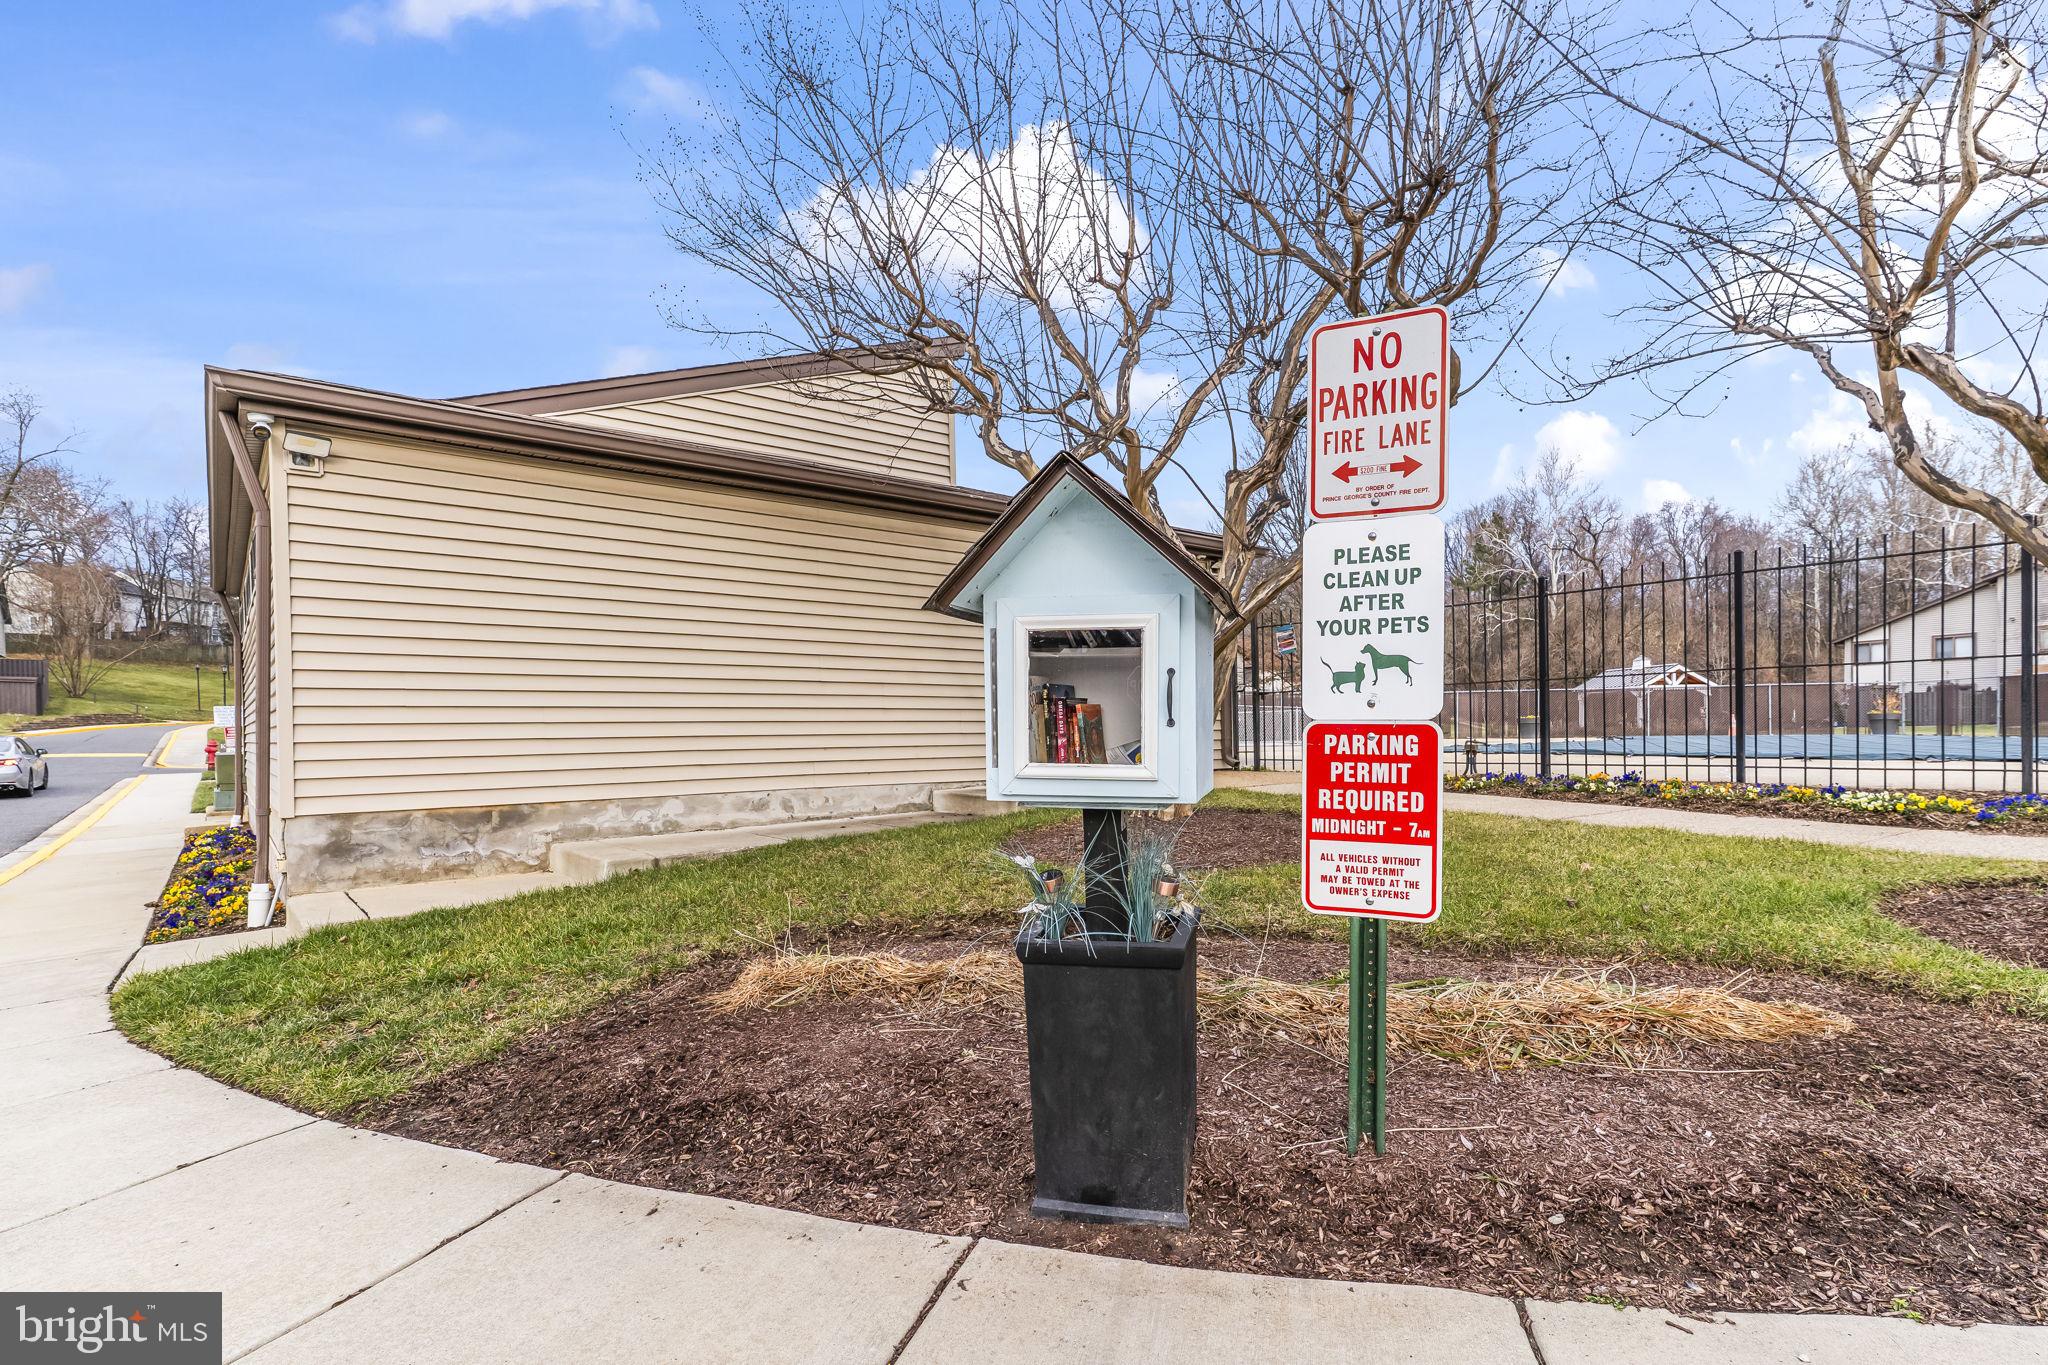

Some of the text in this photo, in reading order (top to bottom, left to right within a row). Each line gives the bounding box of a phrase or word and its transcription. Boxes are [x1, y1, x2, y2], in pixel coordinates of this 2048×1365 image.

[1353, 331, 1402, 373] NO
[1319, 372, 1438, 423] PARKING
[1323, 420, 1431, 455] FIRE LANE
[1360, 465, 1388, 475] $200 FINE
[1344, 492, 1372, 501] GEORGE'S
[1334, 543, 1411, 565] PLEASE
[1323, 567, 1422, 590] CLEAN UP
[1339, 592, 1405, 612] AFTER
[1316, 615, 1430, 636] YOUR PETS
[1324, 734, 1419, 757] PARKING
[1330, 762, 1412, 784] PERMIT
[1318, 788, 1424, 814] REQUIRED
[1311, 818, 1386, 836] MIDNIGHT
[1320, 853, 1421, 867] ALL VEHICLES WITHOUT
[1335, 865, 1405, 877] A VALID PERMIT
[1320, 875, 1420, 889] MAY BE TOWED AT THE
[1329, 886, 1410, 900] OWNER'S EXPENSE
